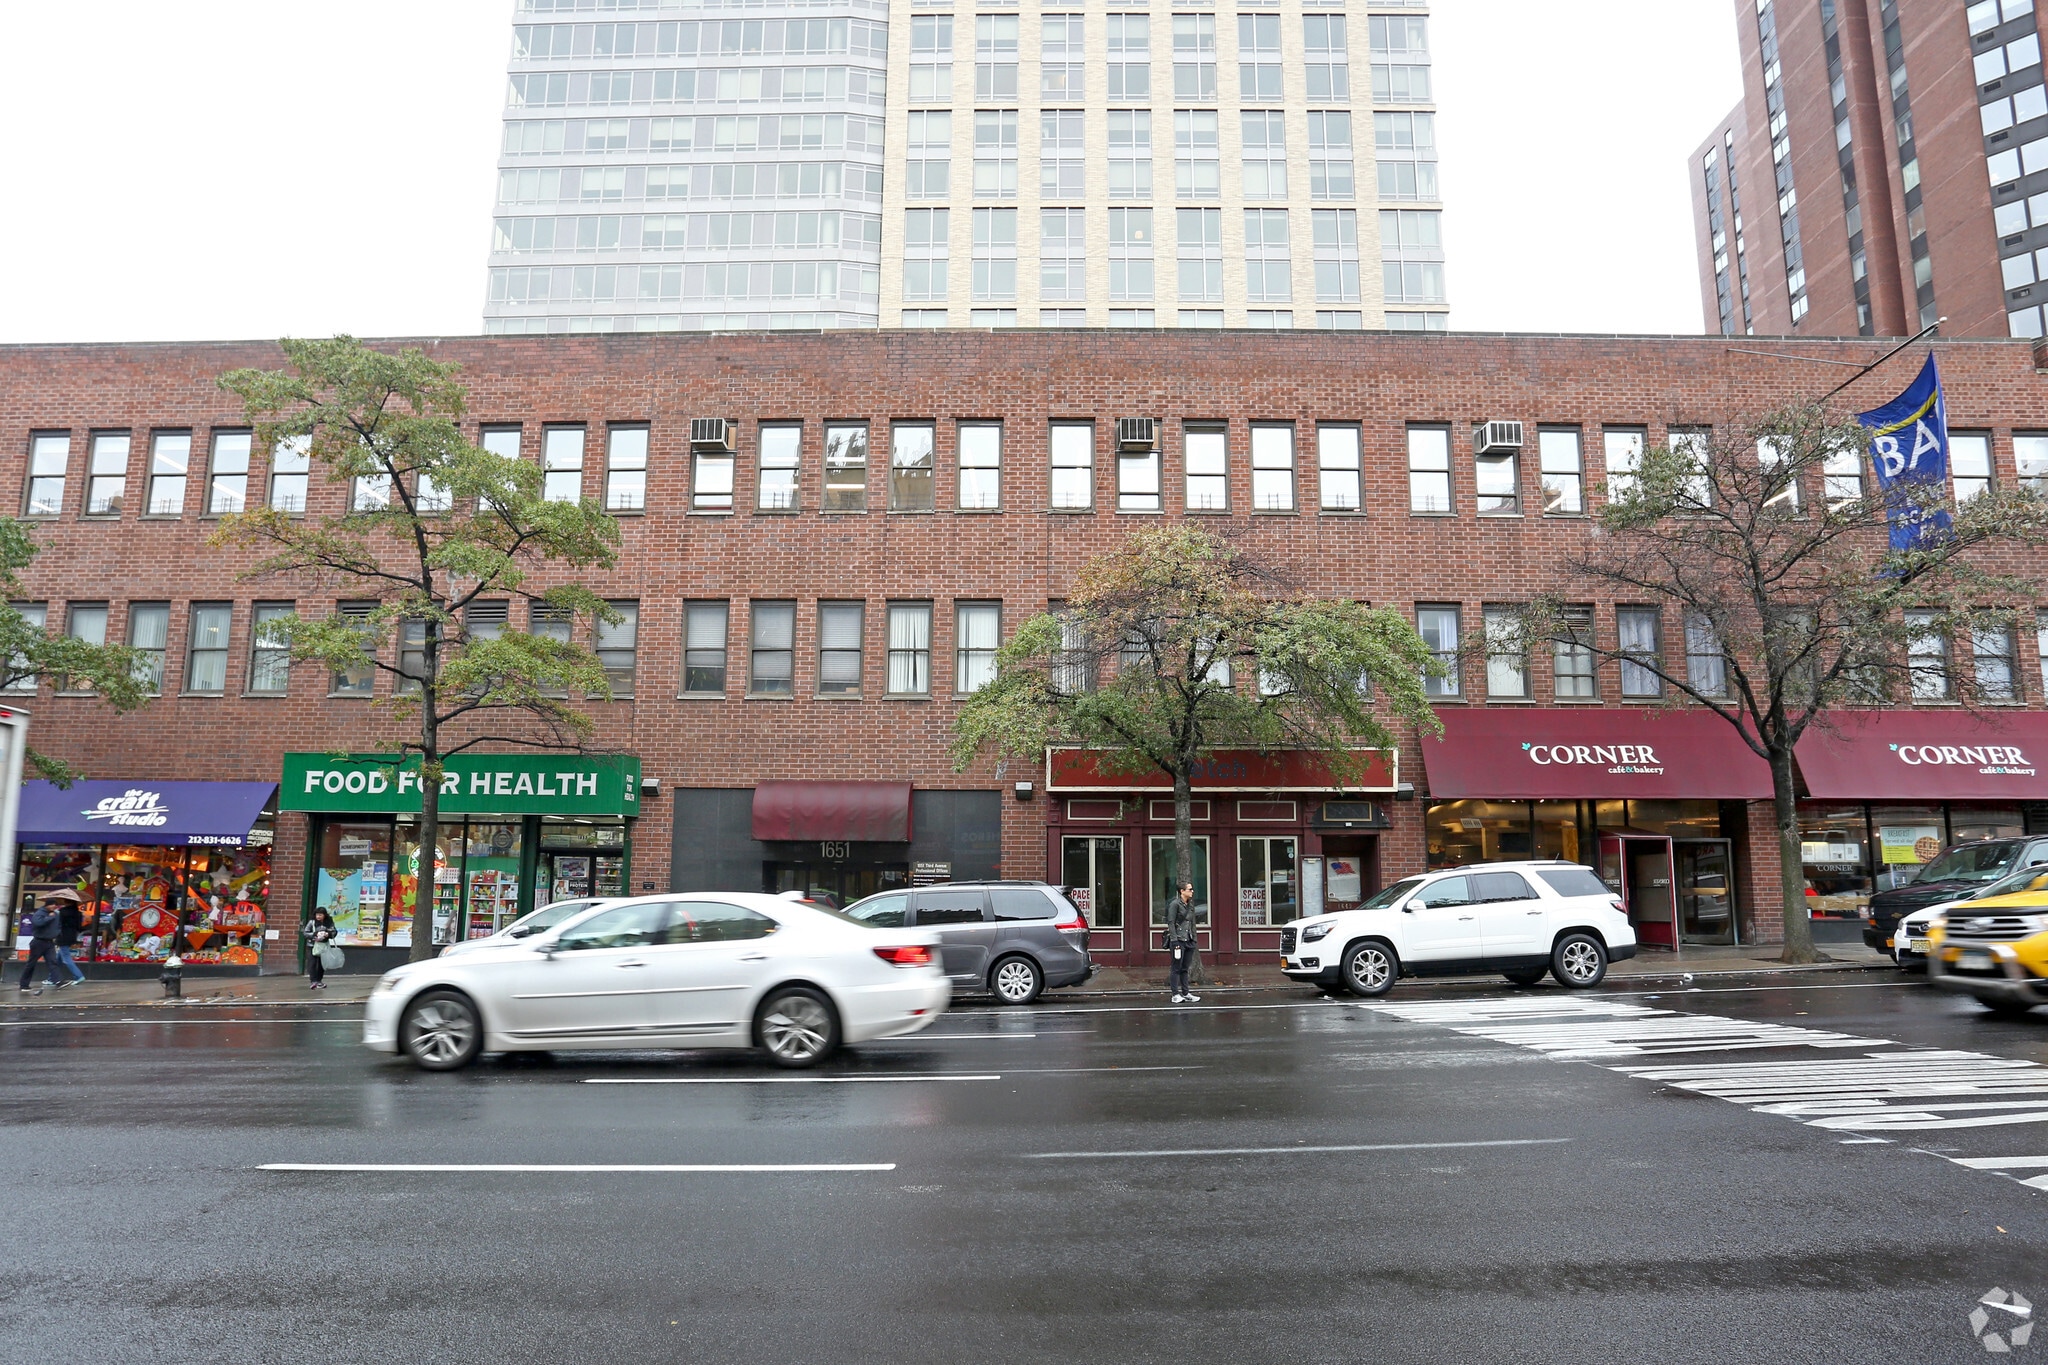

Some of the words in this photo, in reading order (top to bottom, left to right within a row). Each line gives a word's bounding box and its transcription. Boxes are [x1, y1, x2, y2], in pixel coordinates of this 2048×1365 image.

[1875, 419, 1940, 477] BA
[1529, 745, 1661, 765] CORNER
[1899, 745, 2031, 765] CORNER
[304, 770, 389, 794] FOOD
[469, 772, 598, 796] HEALTH
[124, 789, 143, 797] the
[97, 792, 160, 811] craft
[109, 813, 167, 826] studio
[188, 836, 241, 844] 212-831-6626
[820, 842, 850, 858] 1651
[1816, 864, 1852, 872] CORNER
[1243, 890, 1265, 899] SPACE
